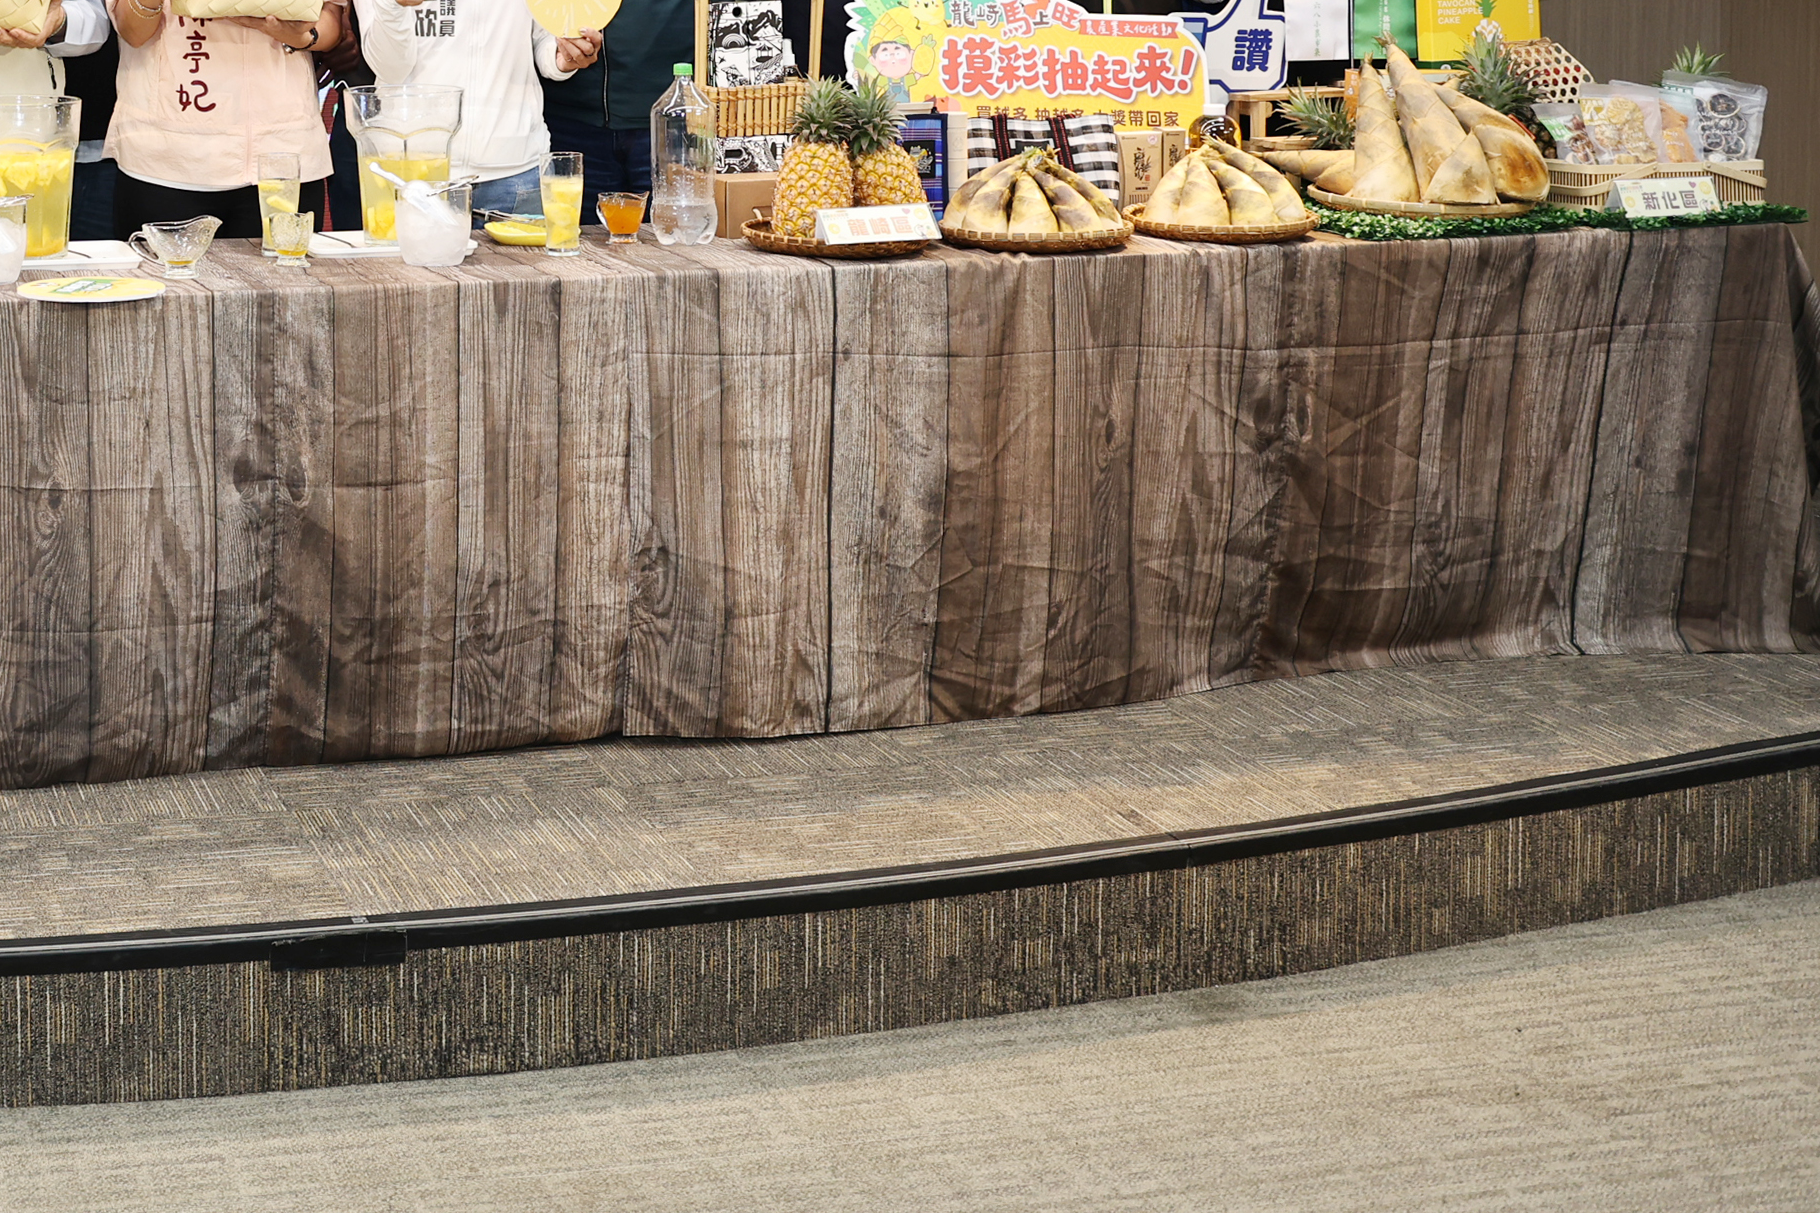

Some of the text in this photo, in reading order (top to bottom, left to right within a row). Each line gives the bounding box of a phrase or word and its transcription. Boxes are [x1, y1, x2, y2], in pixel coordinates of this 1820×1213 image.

[1437, 6, 1484, 15] PINEAPPLE
[1438, 16, 1461, 25] CAKE
[1232, 28, 1273, 72] 讚
[175, 16, 217, 112] 亭妃
[942, 37, 1196, 101] 摸彩抽起來!
[1640, 189, 1699, 211] 新化區
[847, 216, 914, 237] 龍崎區
